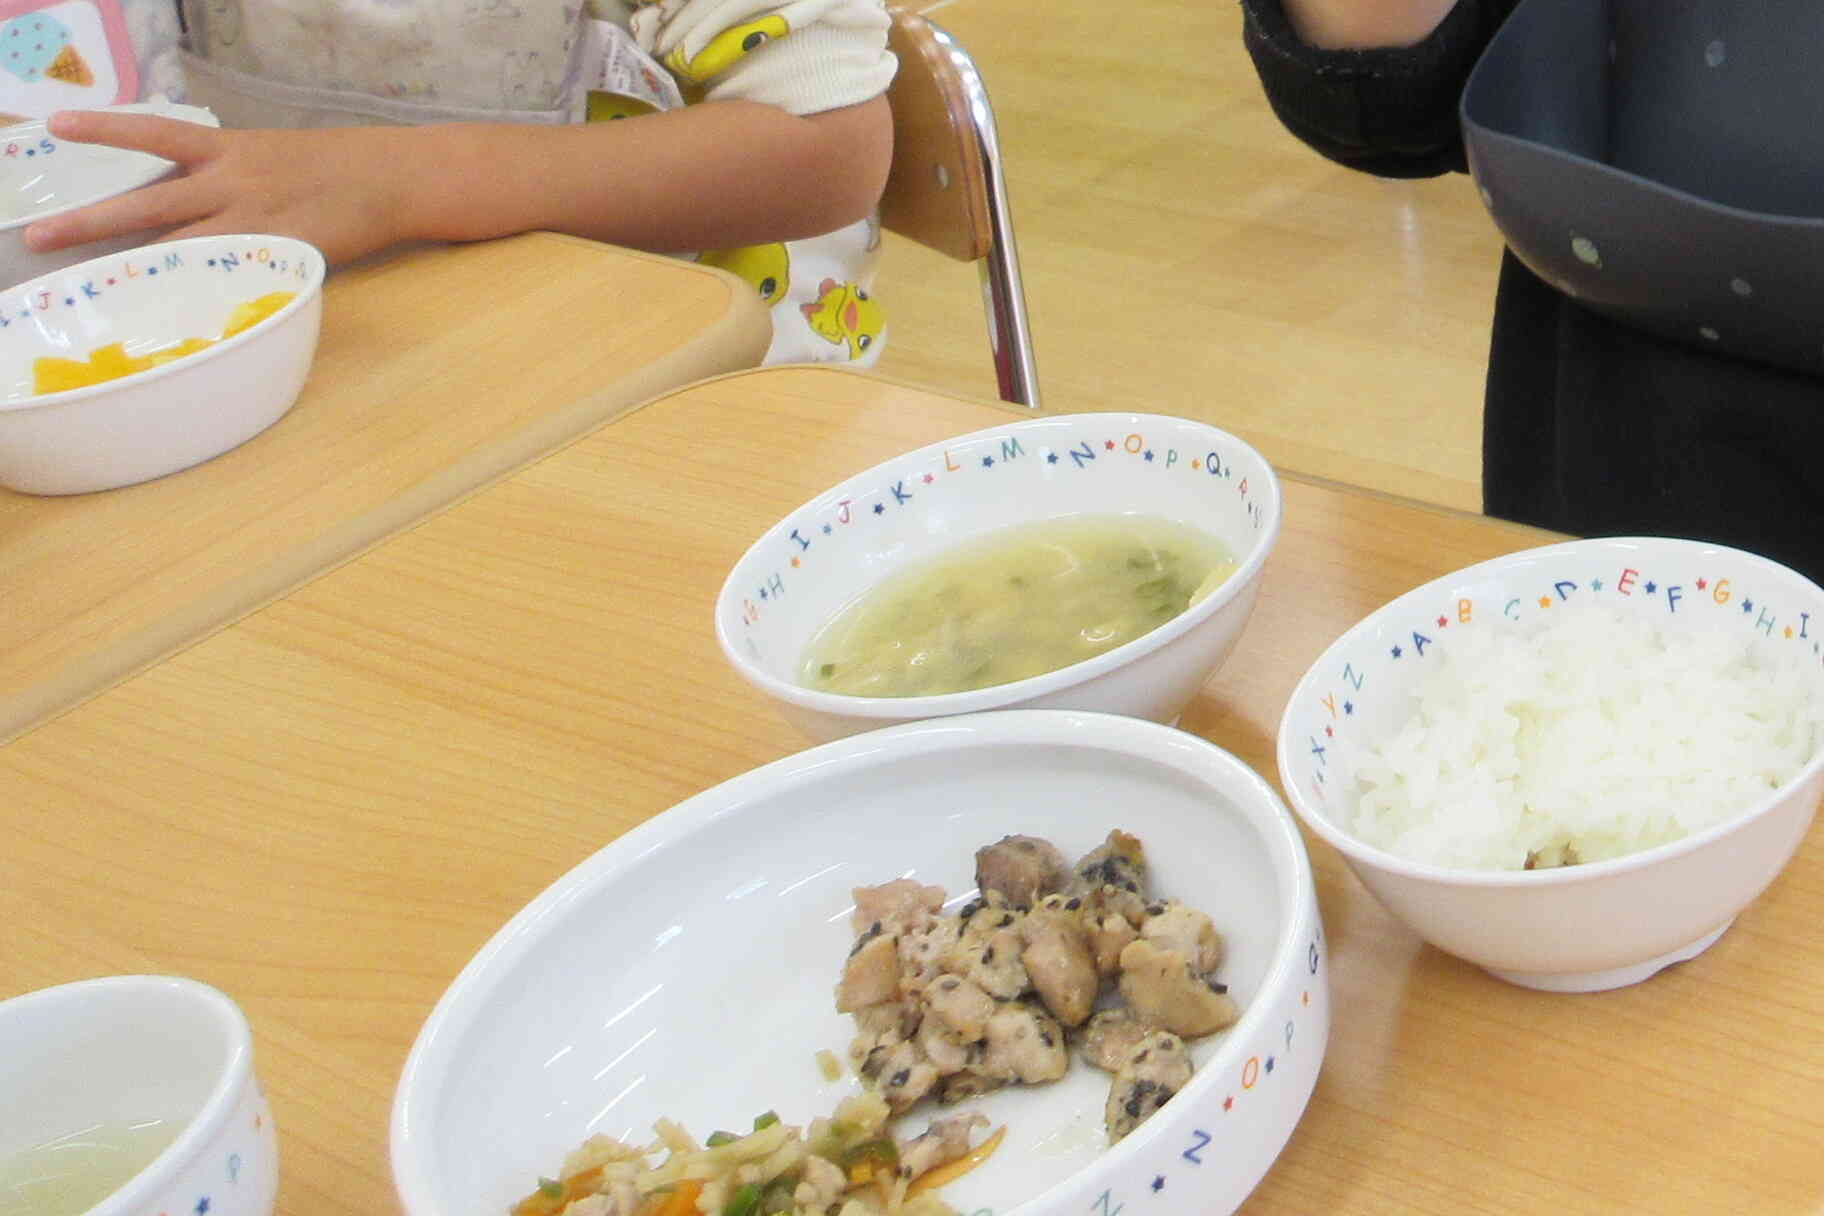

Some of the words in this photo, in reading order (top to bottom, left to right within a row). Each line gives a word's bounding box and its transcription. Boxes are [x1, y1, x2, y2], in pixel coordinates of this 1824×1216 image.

[39, 140, 56, 154] S
[80, 281, 101, 298] K
[125, 263, 141, 278] L
[257, 248, 269, 263] O
[767, 573, 784, 600] H
[790, 529, 810, 552] I
[838, 500, 854, 524] J
[891, 481, 912, 505] K
[944, 451, 960, 472] L
[1000, 437, 1024, 462] M
[1069, 441, 1096, 468] N
[1124, 434, 1144, 454] O
[1166, 449, 1178, 469] P
[1207, 452, 1222, 477] Q
[1413, 632, 1432, 656] A
[1457, 600, 1472, 624] B
[1504, 598, 1520, 621] C
[1617, 568, 1639, 596] E
[1667, 586, 1682, 613] F
[1713, 579, 1730, 605] G
[1756, 607, 1776, 637] H
[1800, 612, 1809, 639] I
[1242, 1056, 1259, 1089] O
